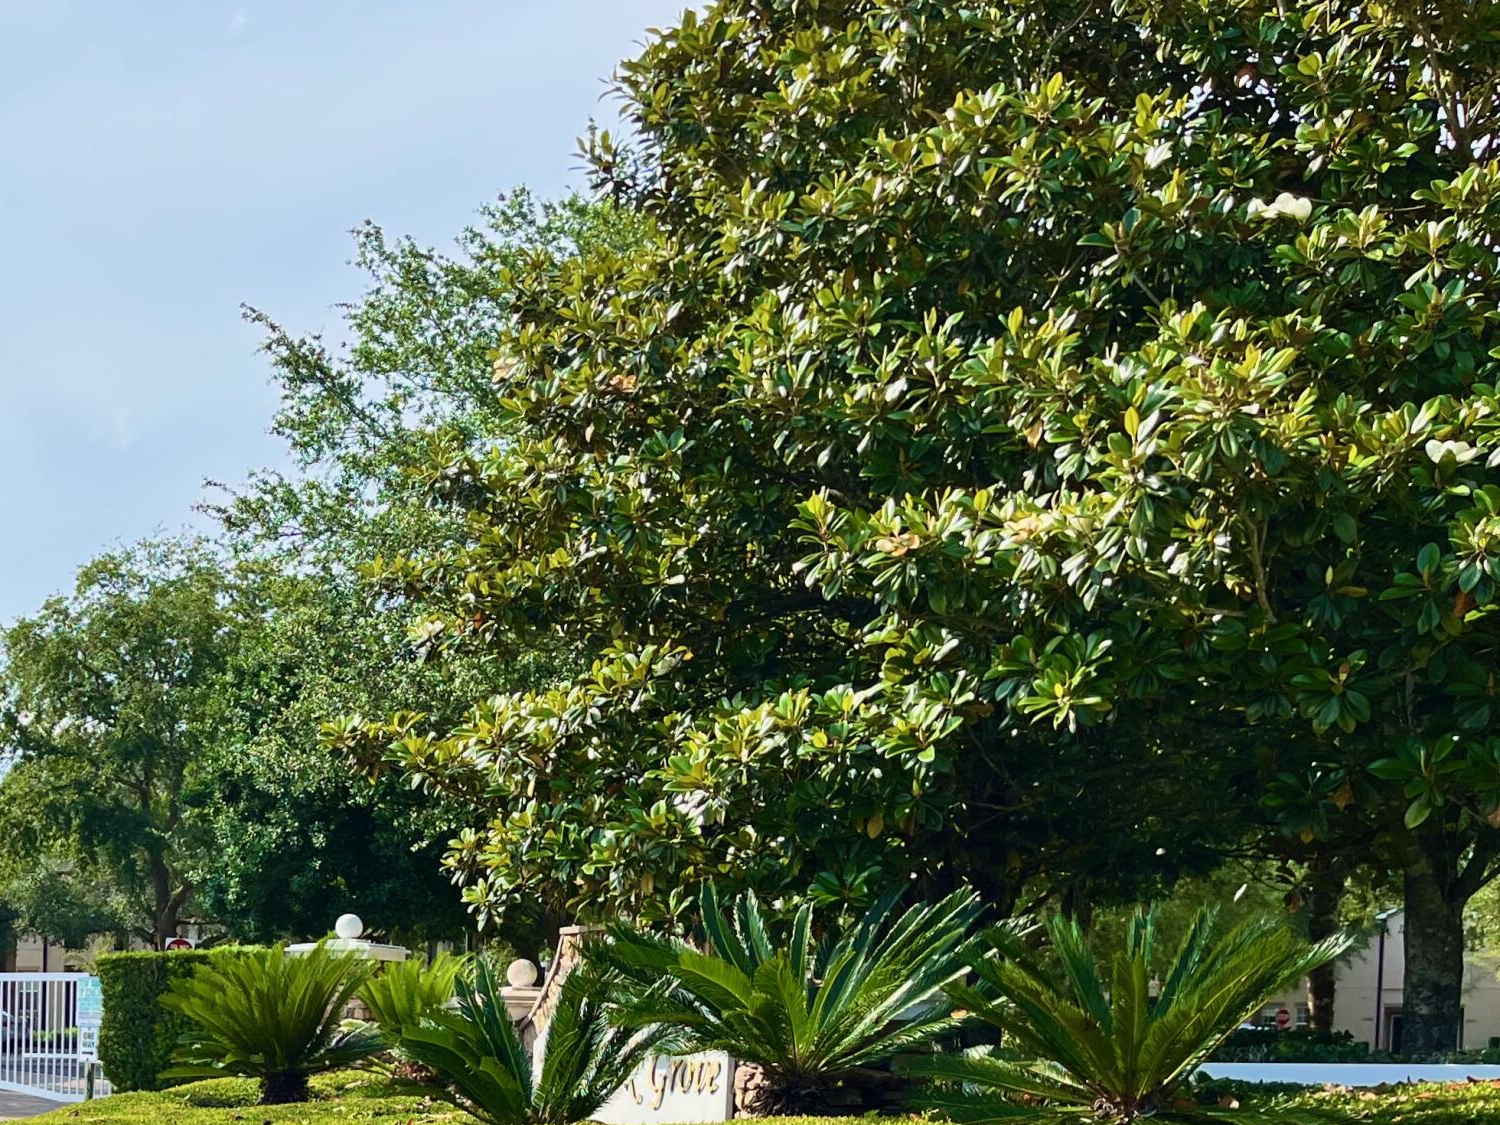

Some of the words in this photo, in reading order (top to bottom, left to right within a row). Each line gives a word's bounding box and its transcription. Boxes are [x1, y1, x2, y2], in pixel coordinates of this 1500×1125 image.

[83, 1032, 95, 1040] ONE
[82, 1041, 95, 1049] WAY
[650, 1054, 722, 1111] Grove
